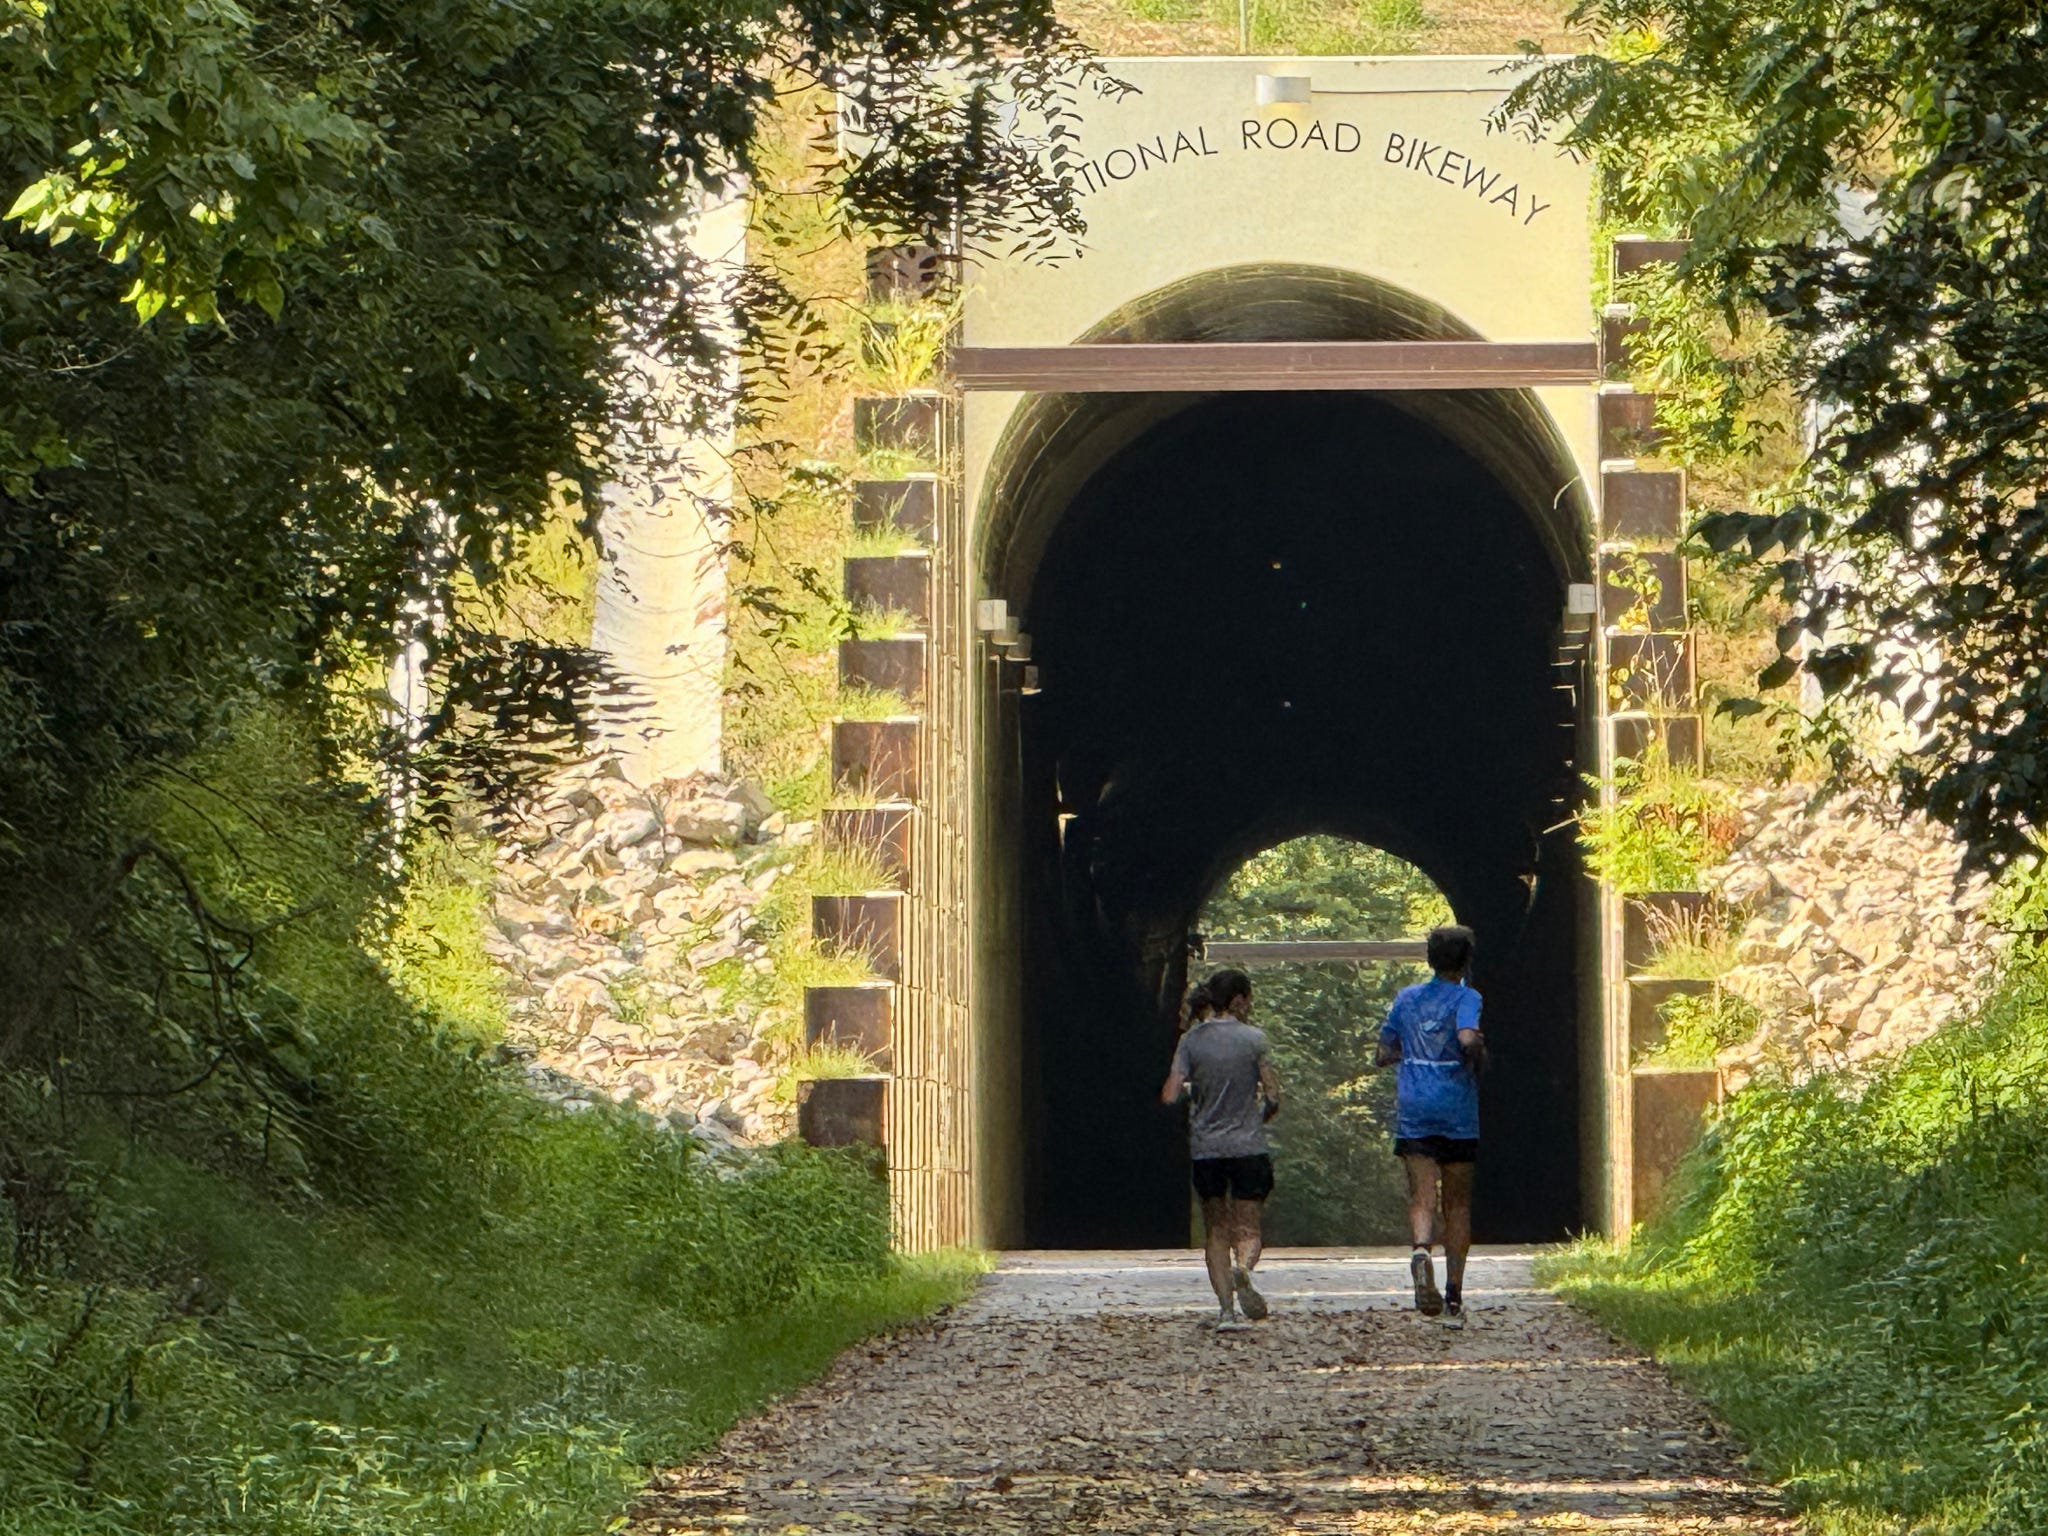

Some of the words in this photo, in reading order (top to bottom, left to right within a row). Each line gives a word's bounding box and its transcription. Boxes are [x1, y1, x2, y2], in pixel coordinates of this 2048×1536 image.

[1074, 126, 1219, 194] TIONAL
[1241, 118, 1361, 153] ROAD
[1384, 132, 1551, 225] BIKEWAY
